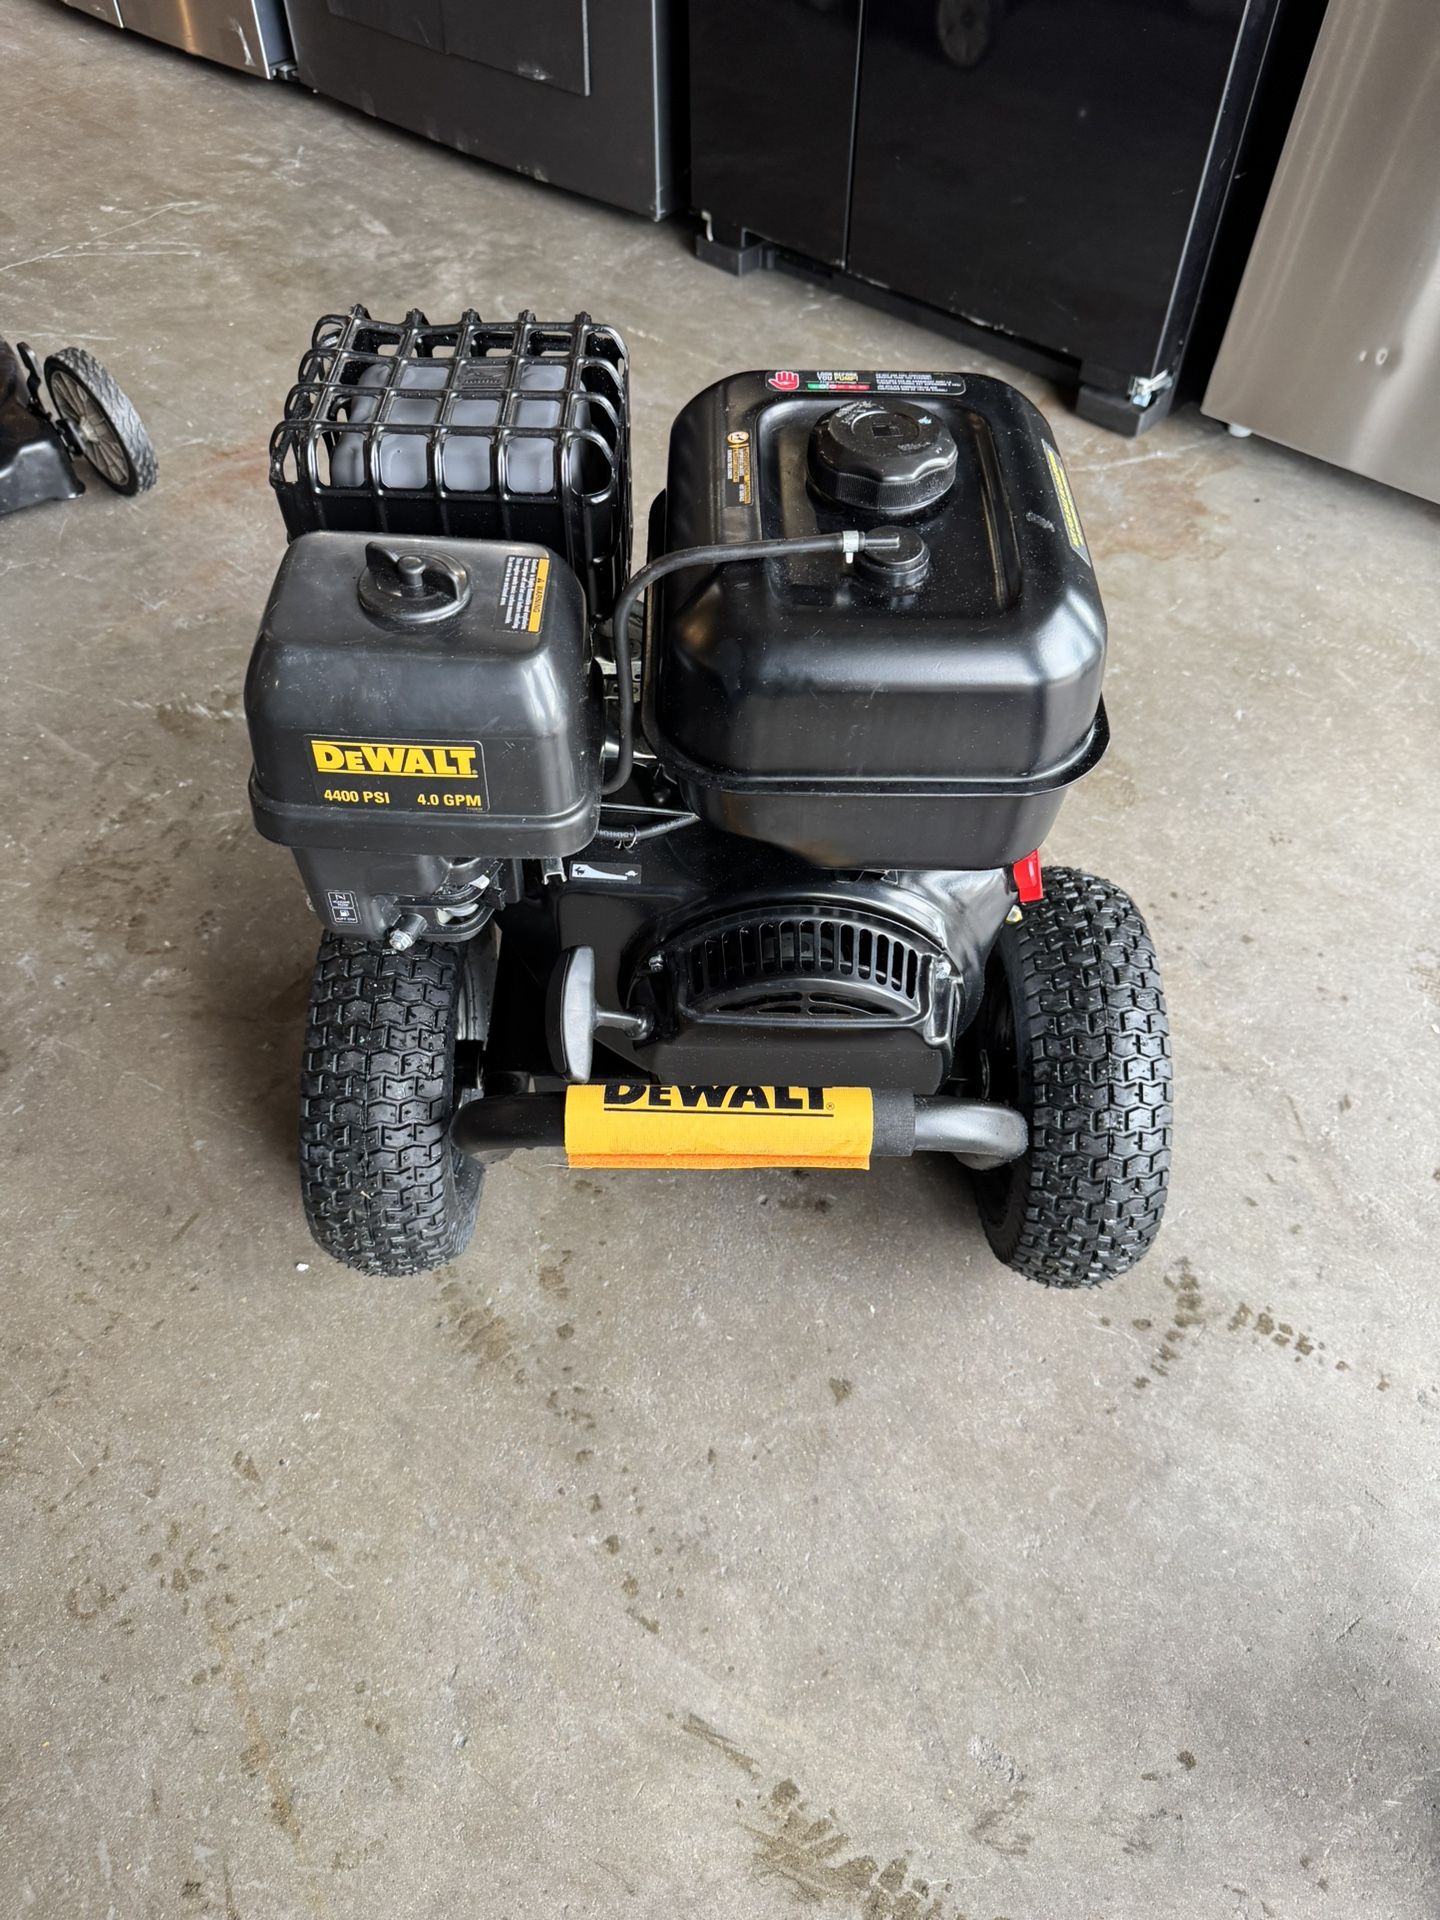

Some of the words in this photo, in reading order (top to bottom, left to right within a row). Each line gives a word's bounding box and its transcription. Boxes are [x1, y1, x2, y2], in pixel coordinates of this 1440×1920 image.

[533, 586, 544, 612] WARNING
[324, 789, 359, 802] 4400
[363, 791, 390, 804] PSI
[417, 793, 439, 806] 4.0
[443, 794, 482, 807] GPM
